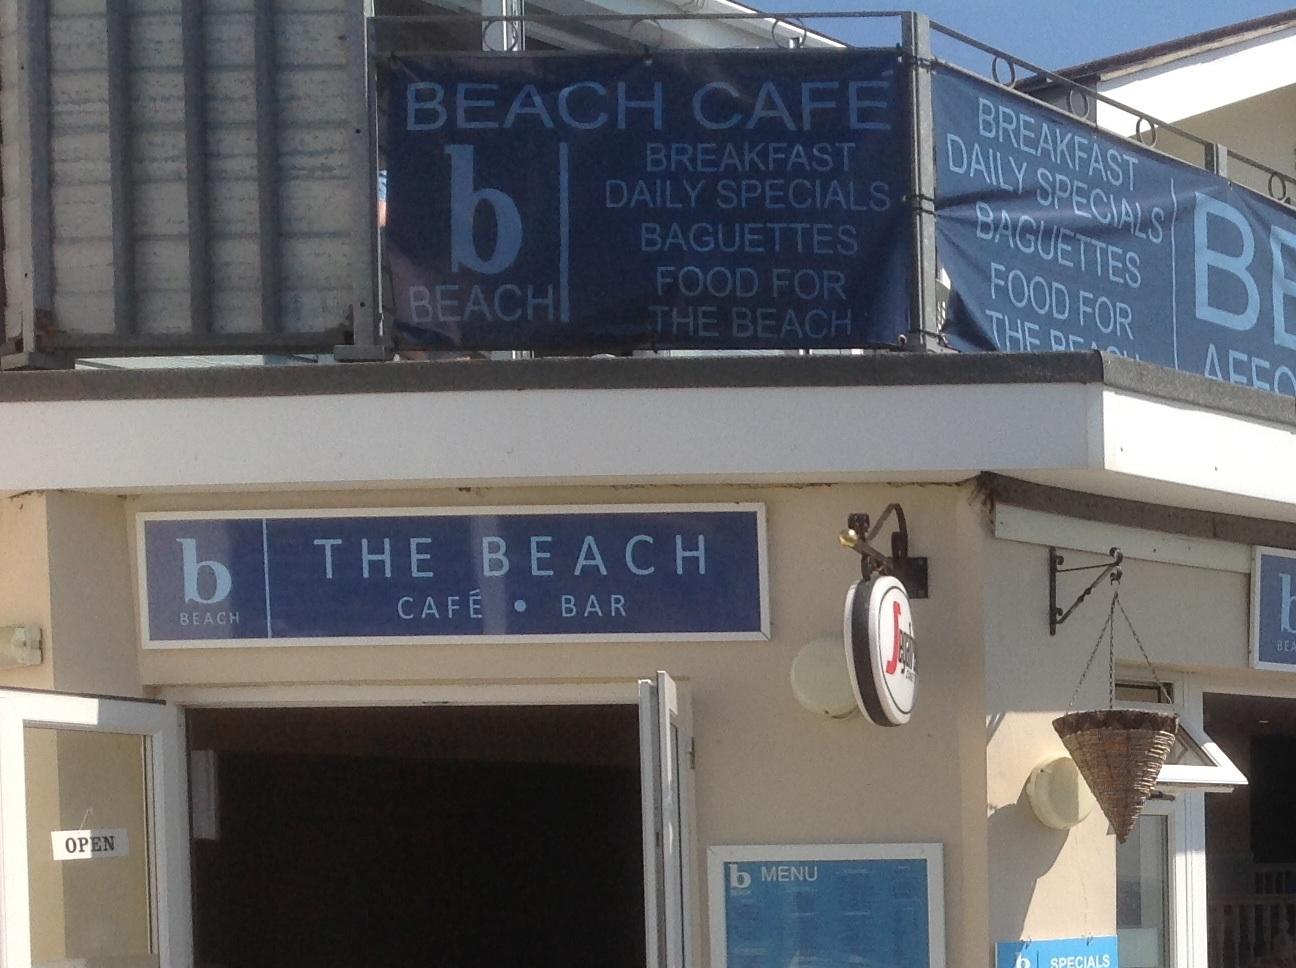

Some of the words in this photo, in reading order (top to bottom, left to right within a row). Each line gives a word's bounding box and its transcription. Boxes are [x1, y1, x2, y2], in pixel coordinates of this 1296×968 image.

[406, 80, 663, 131] BEACH
[692, 79, 892, 131] CAFE
[646, 142, 856, 173] BREAKFAST
[978, 97, 1139, 191] BREAKFAST
[605, 179, 705, 209] DAILY
[717, 179, 890, 212] SPECIALS
[946, 132, 1027, 195] DAILY
[1036, 167, 1165, 244] SPECIALS
[444, 143, 522, 275] b
[641, 223, 859, 256] BAGUETTES
[975, 201, 1142, 289] BAGUETTES
[656, 265, 758, 298] FOOD
[772, 268, 847, 301] FOR
[990, 262, 1069, 320] FOOD
[1079, 290, 1134, 340] FOR
[408, 284, 554, 324] BEACH
[649, 305, 721, 338] THE
[731, 306, 852, 339] BEACH
[176, 537, 233, 604] b
[314, 537, 434, 580] THE
[482, 534, 707, 577] BEACH
[179, 611, 240, 626] BEACH
[398, 588, 483, 621] CAFÉ
[562, 593, 628, 619] BAR
[65, 835, 116, 855] OPEN
[729, 863, 751, 889] b
[761, 866, 818, 882] MENU
